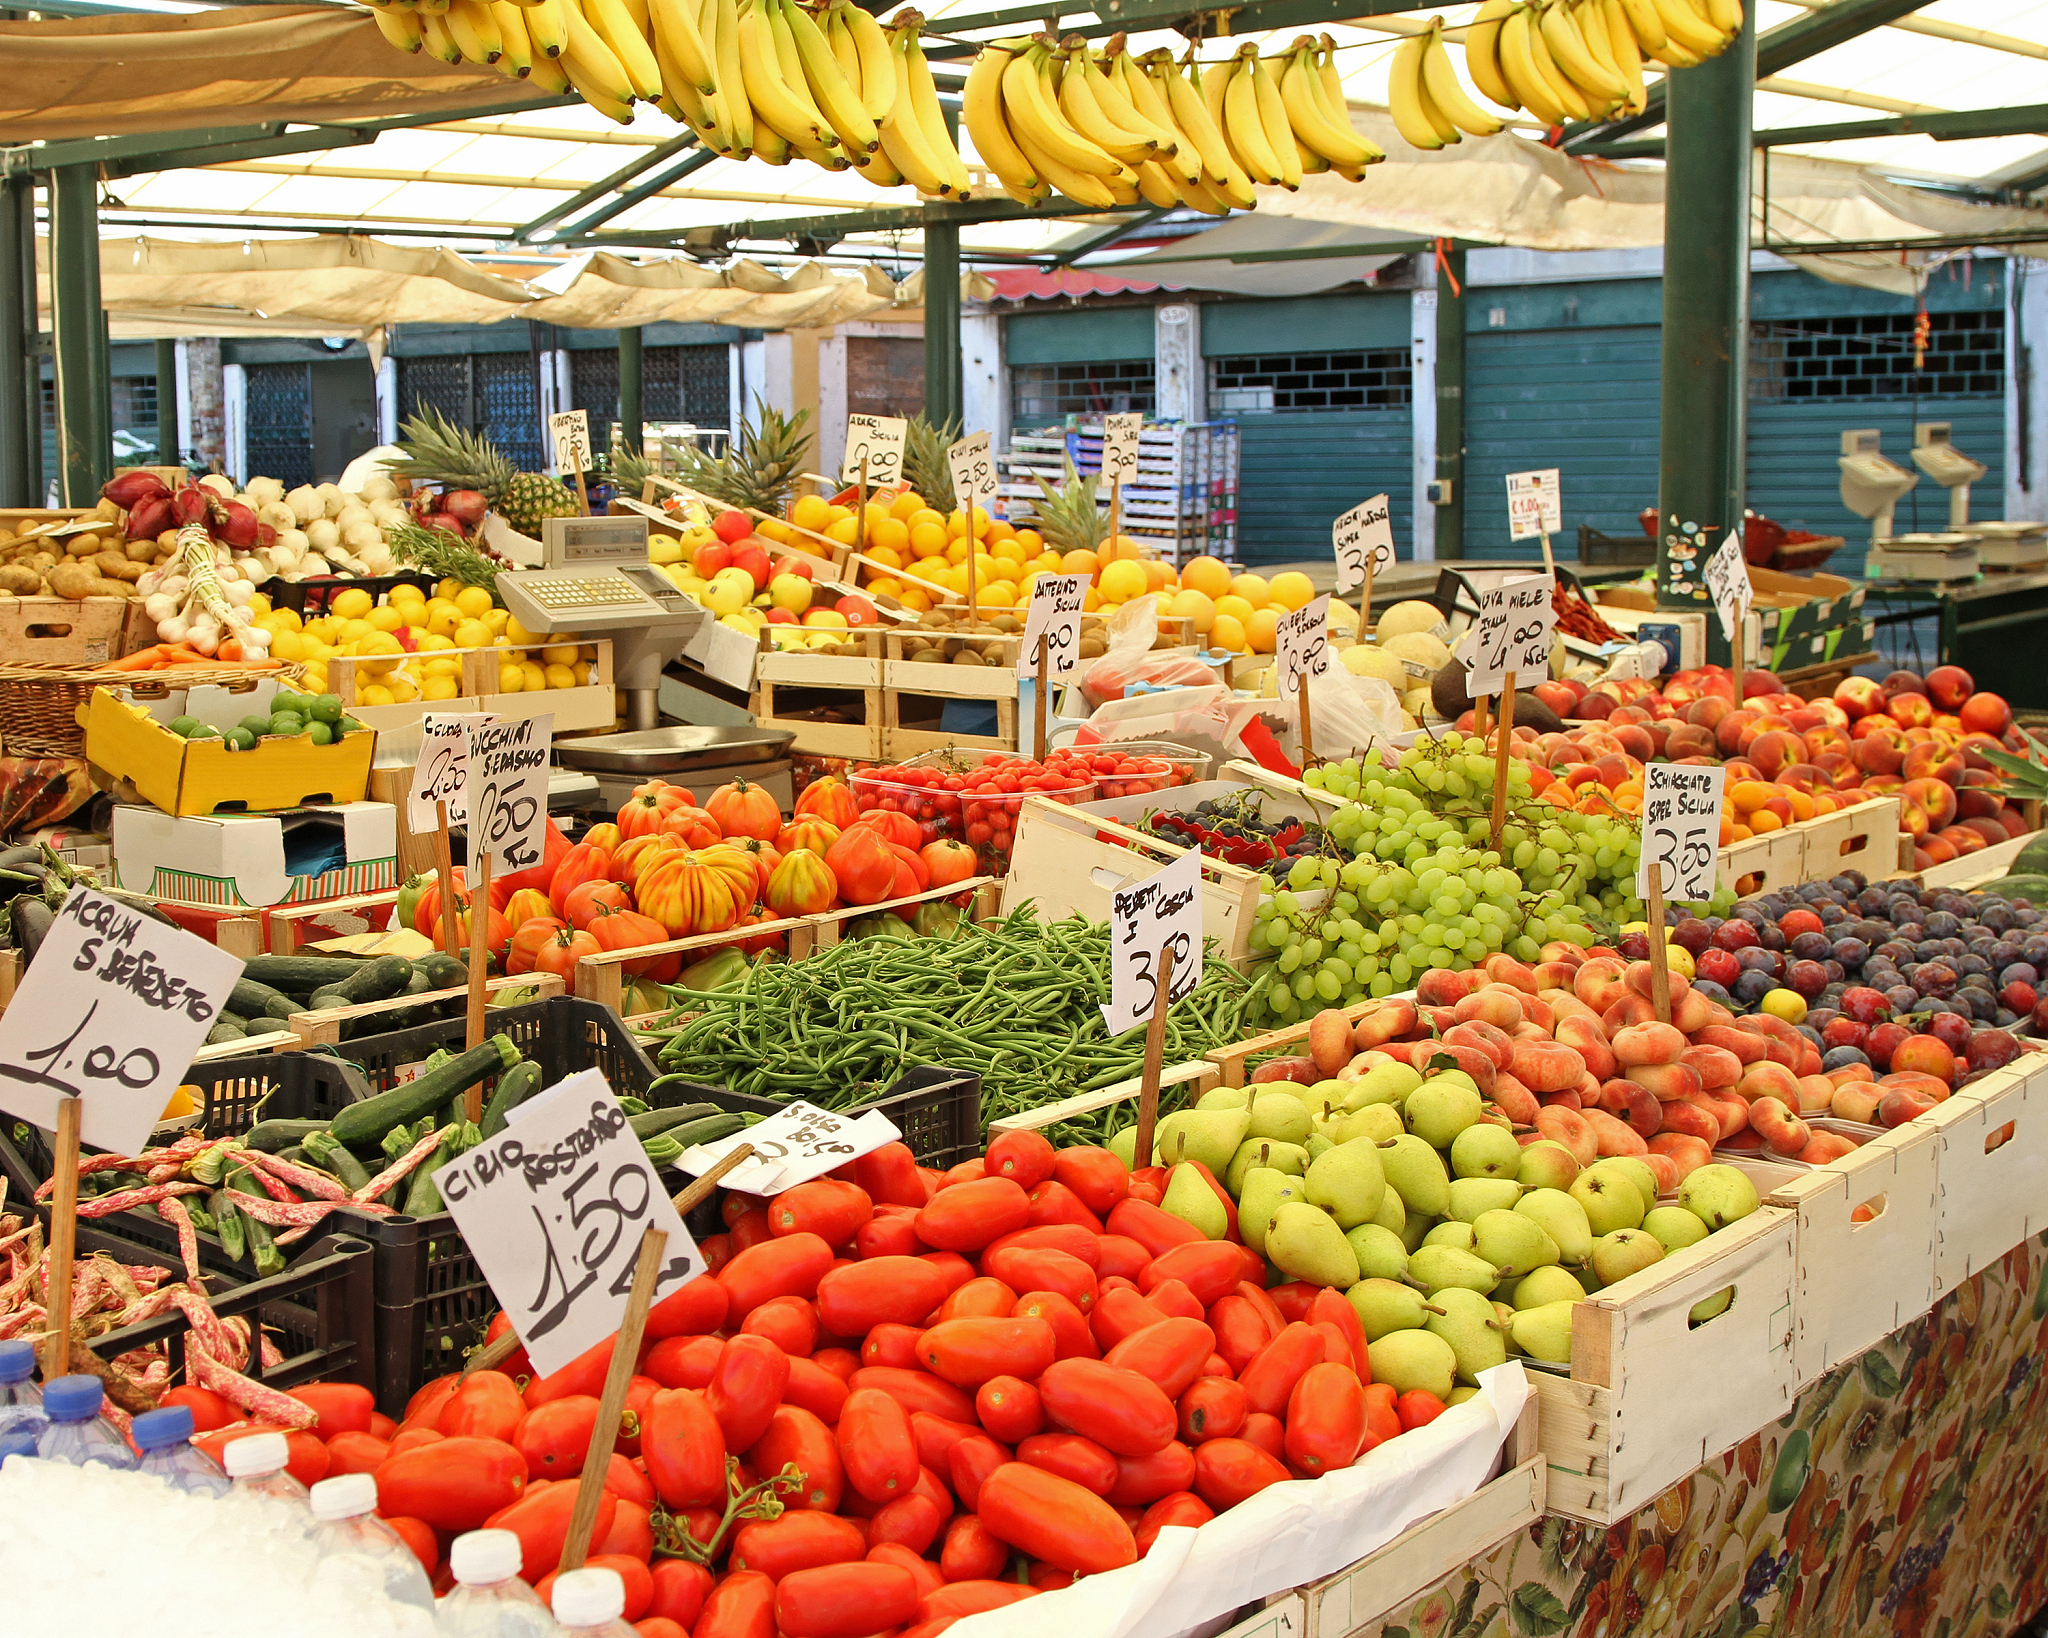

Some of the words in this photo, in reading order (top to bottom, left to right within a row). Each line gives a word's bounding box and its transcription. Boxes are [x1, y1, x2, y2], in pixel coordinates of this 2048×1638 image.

[1481, 591, 1504, 611] UVA
[1508, 589, 1544, 609] MIELE
[62, 890, 142, 948] ACQUA
[443, 1139, 524, 1202] CIRIO
